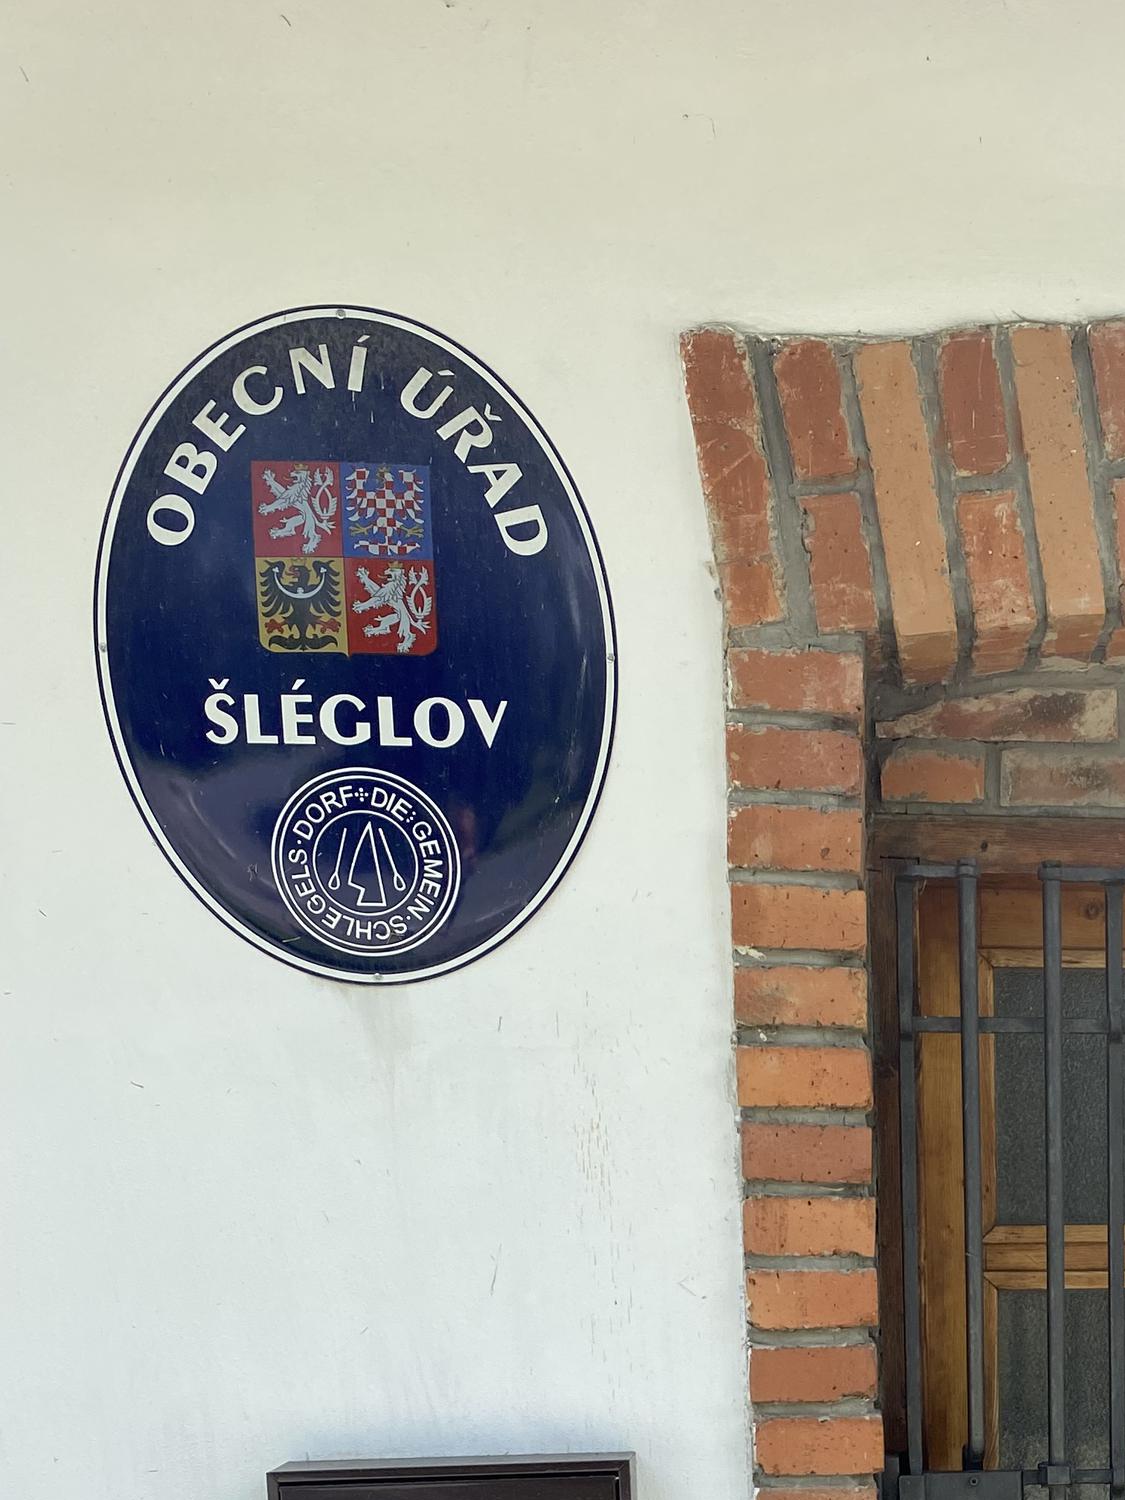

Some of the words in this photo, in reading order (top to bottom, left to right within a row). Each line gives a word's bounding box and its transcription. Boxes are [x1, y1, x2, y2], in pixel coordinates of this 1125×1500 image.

[146, 335, 370, 546] OBECNÍ
[401, 367, 549, 557] ÚŘAD
[203, 678, 508, 749] ŠLÉGLOV
[370, 786, 413, 822] DIE
[406, 821, 443, 921] GEMEIN
